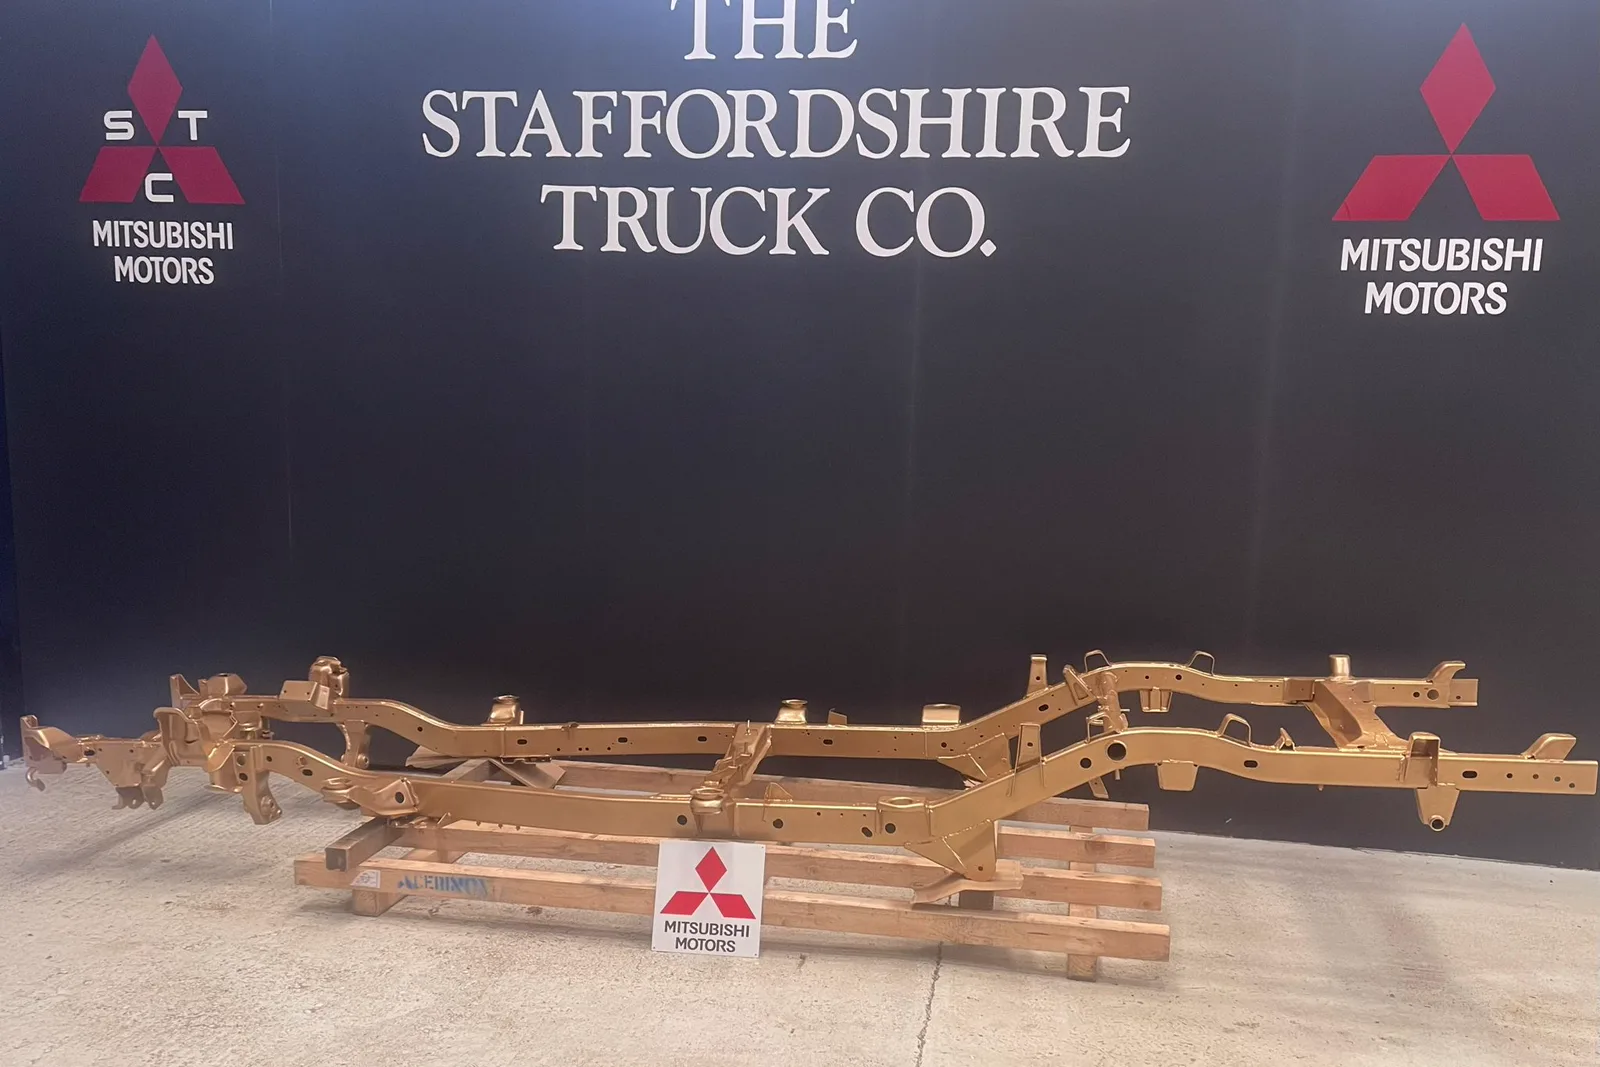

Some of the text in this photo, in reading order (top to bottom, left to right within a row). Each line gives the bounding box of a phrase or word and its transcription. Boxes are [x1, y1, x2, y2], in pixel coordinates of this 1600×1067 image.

[669, 0, 858, 61] THE
[103, 110, 208, 141] S T
[421, 86, 1131, 160] STAFFORDSHIRE
[144, 172, 175, 203] C
[92, 219, 234, 250] MITSUBISHI
[540, 184, 997, 258] TRUCK CO.
[114, 255, 215, 285] MOTORS
[1340, 237, 1544, 272] MITSUBISHI
[1364, 281, 1508, 315] MOTORS
[664, 920, 750, 938] MITSUBISHI
[675, 936, 736, 953] MOTORS
